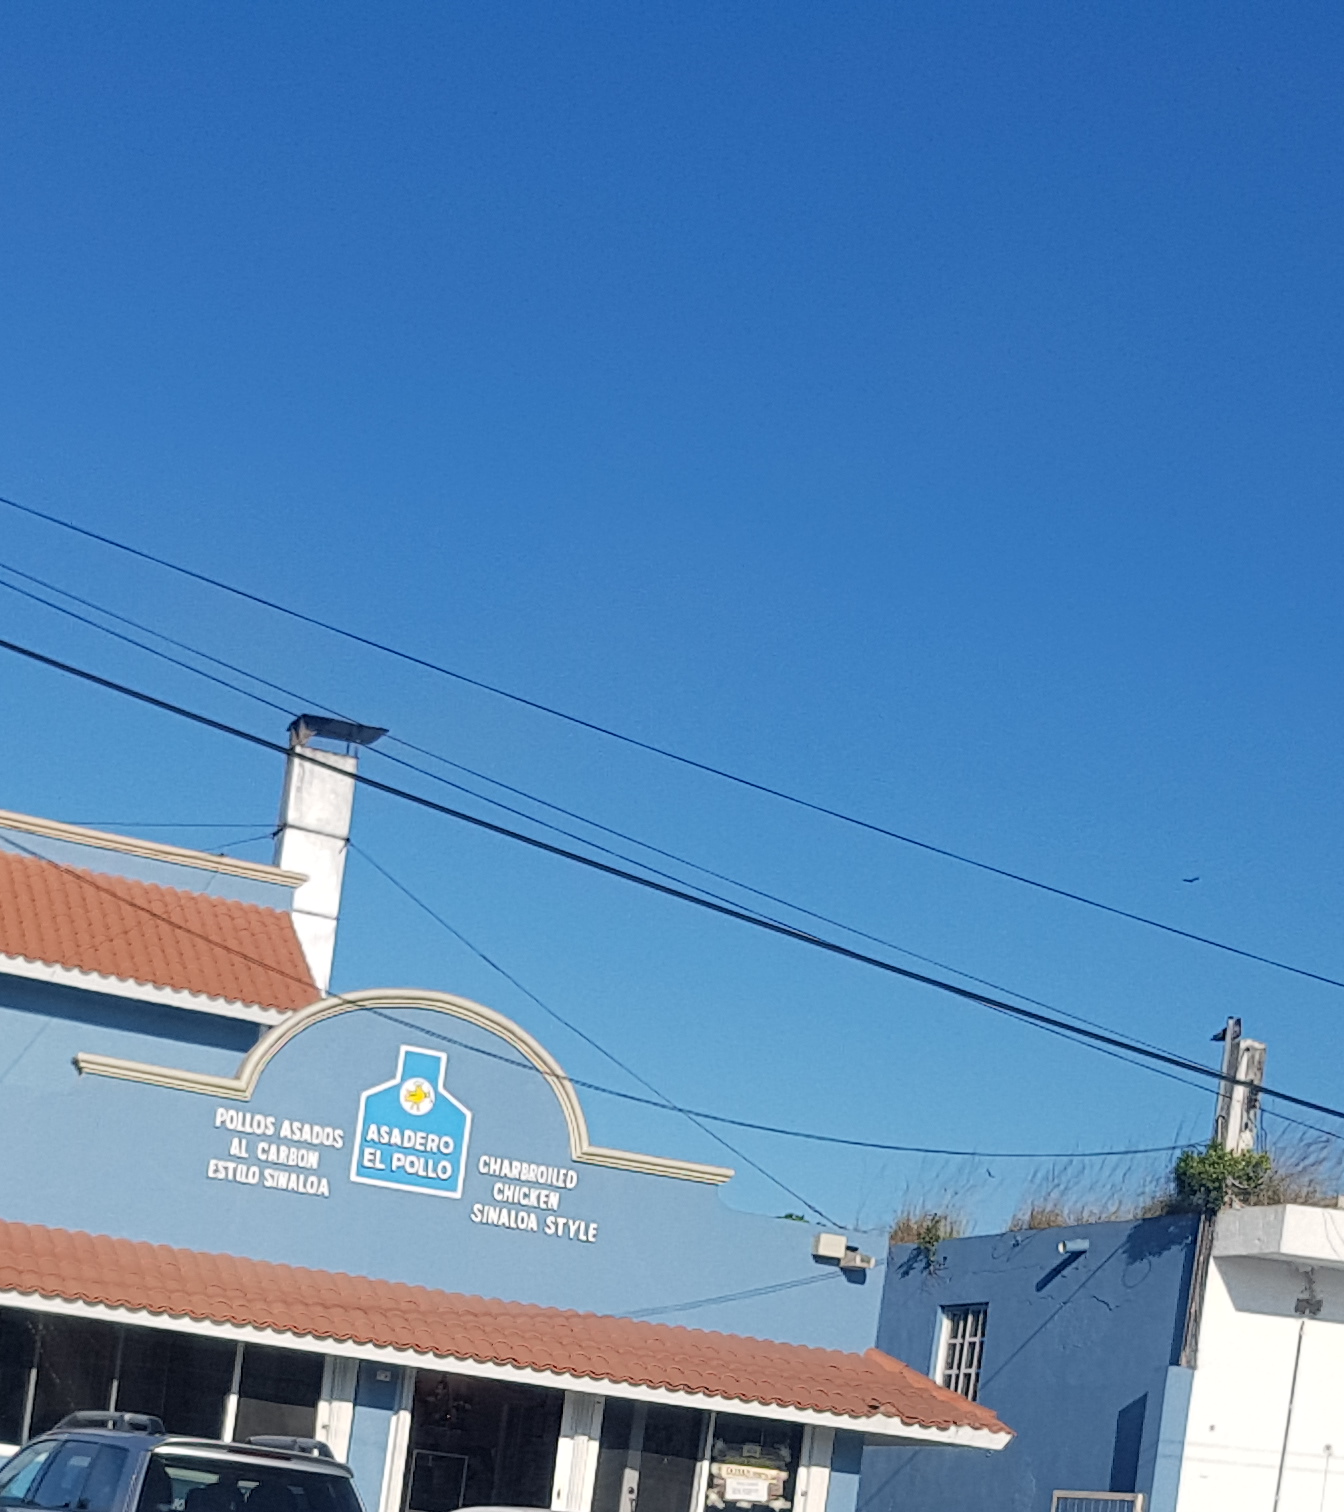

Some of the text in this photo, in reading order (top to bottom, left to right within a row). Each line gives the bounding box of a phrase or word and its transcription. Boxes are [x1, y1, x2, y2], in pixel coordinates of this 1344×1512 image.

[215, 1107, 344, 1149] POLLOS ASADOS
[365, 1123, 454, 1154] ASADERO
[229, 1137, 320, 1169] AL CARBON
[363, 1147, 452, 1180] EL POLLO
[208, 1159, 330, 1197] ESTILO SINALOA
[478, 1155, 578, 1189] CHARBROILED
[493, 1182, 560, 1211] CHICKEN
[470, 1203, 598, 1243] SINALOA STYLE
